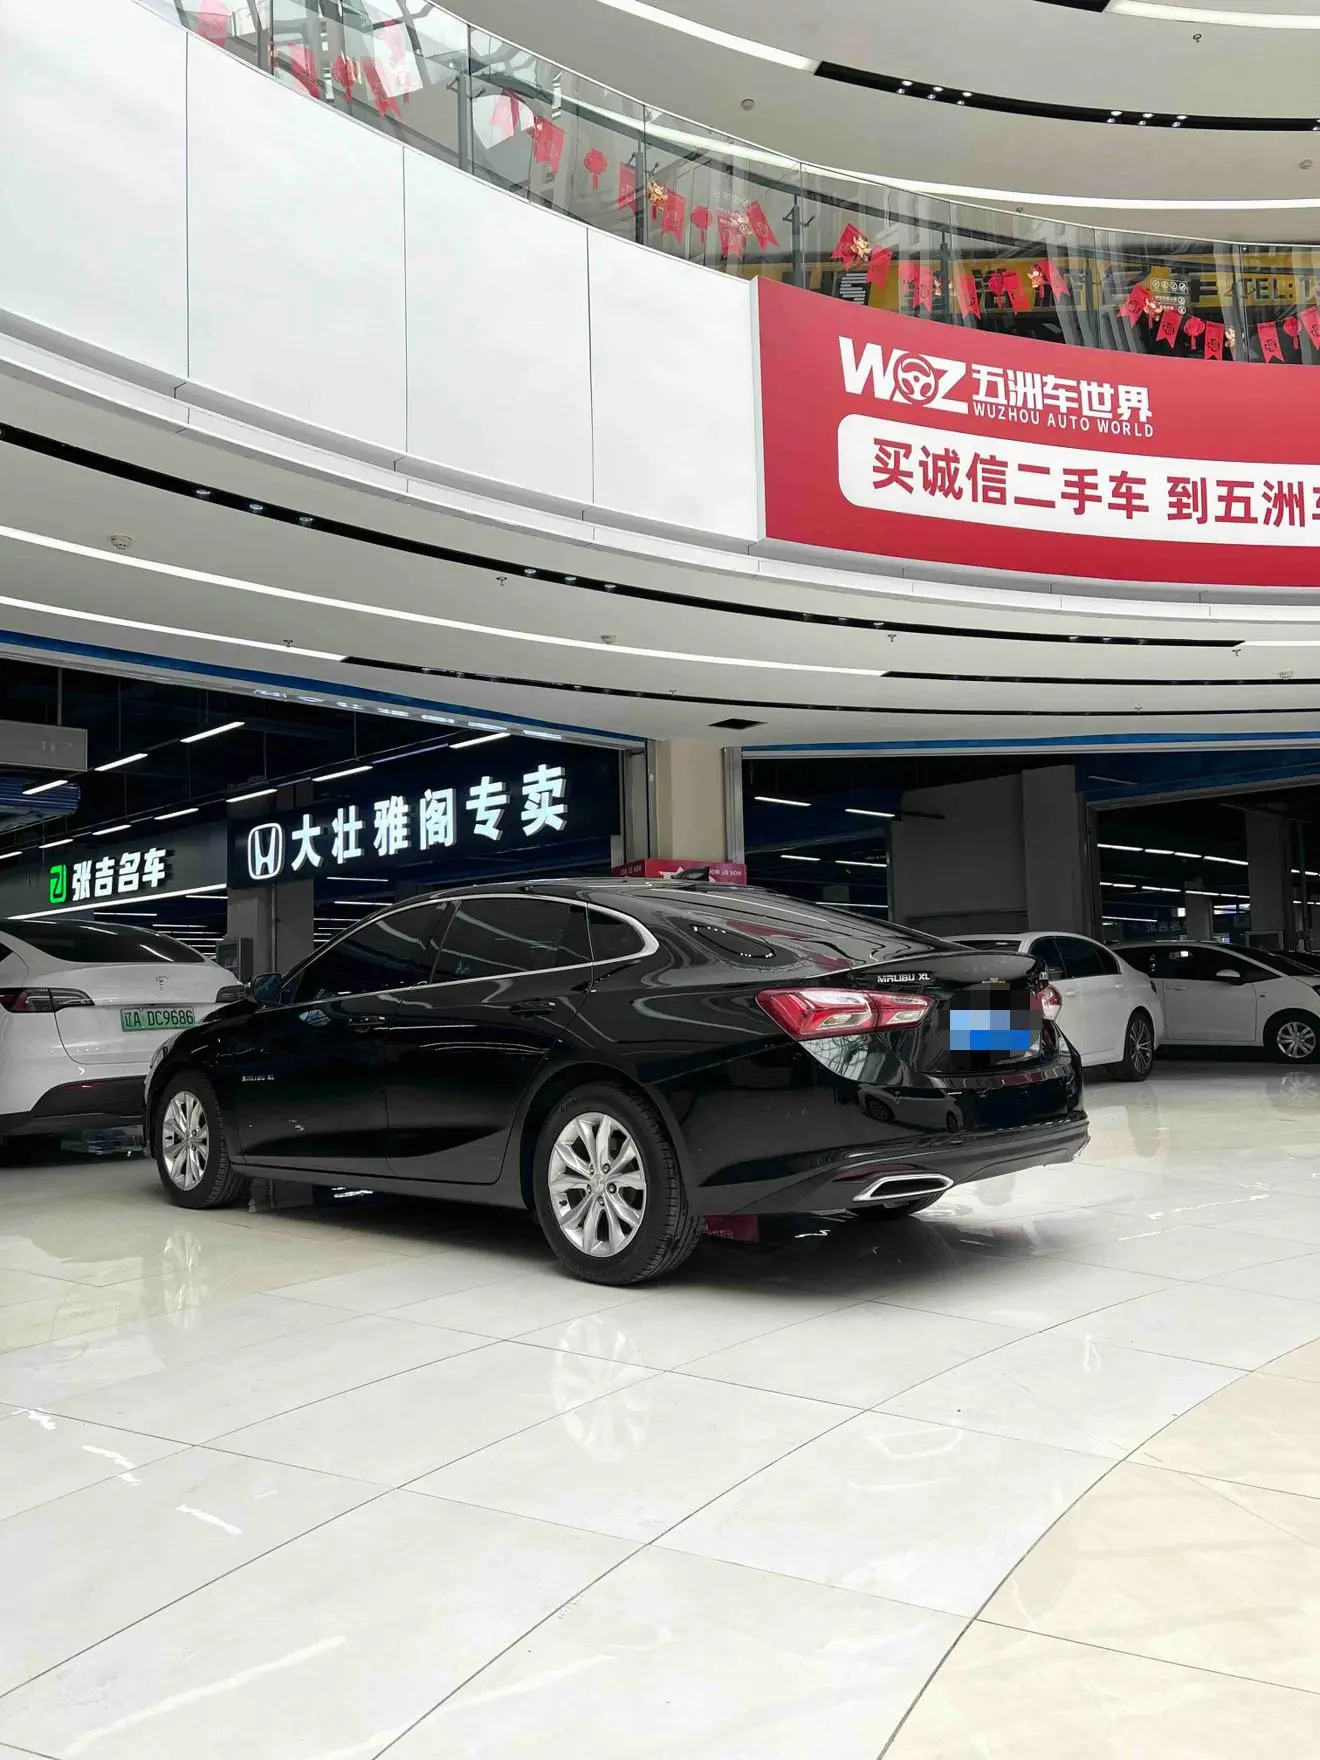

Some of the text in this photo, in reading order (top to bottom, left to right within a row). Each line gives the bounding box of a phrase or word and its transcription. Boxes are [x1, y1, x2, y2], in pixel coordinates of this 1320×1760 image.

[972, 365, 1153, 423] 五洲车世界
[973, 402, 1154, 438] WUZHOU AUTO WORLD
[872, 437, 1149, 520] 买诚信二手车
[291, 764, 568, 871] 大壮雅阁专卖
[72, 848, 167, 901] 张吉名车
[877, 972, 930, 983] MALIBU XL
[124, 1009, 194, 1028] 辽A DC9686
